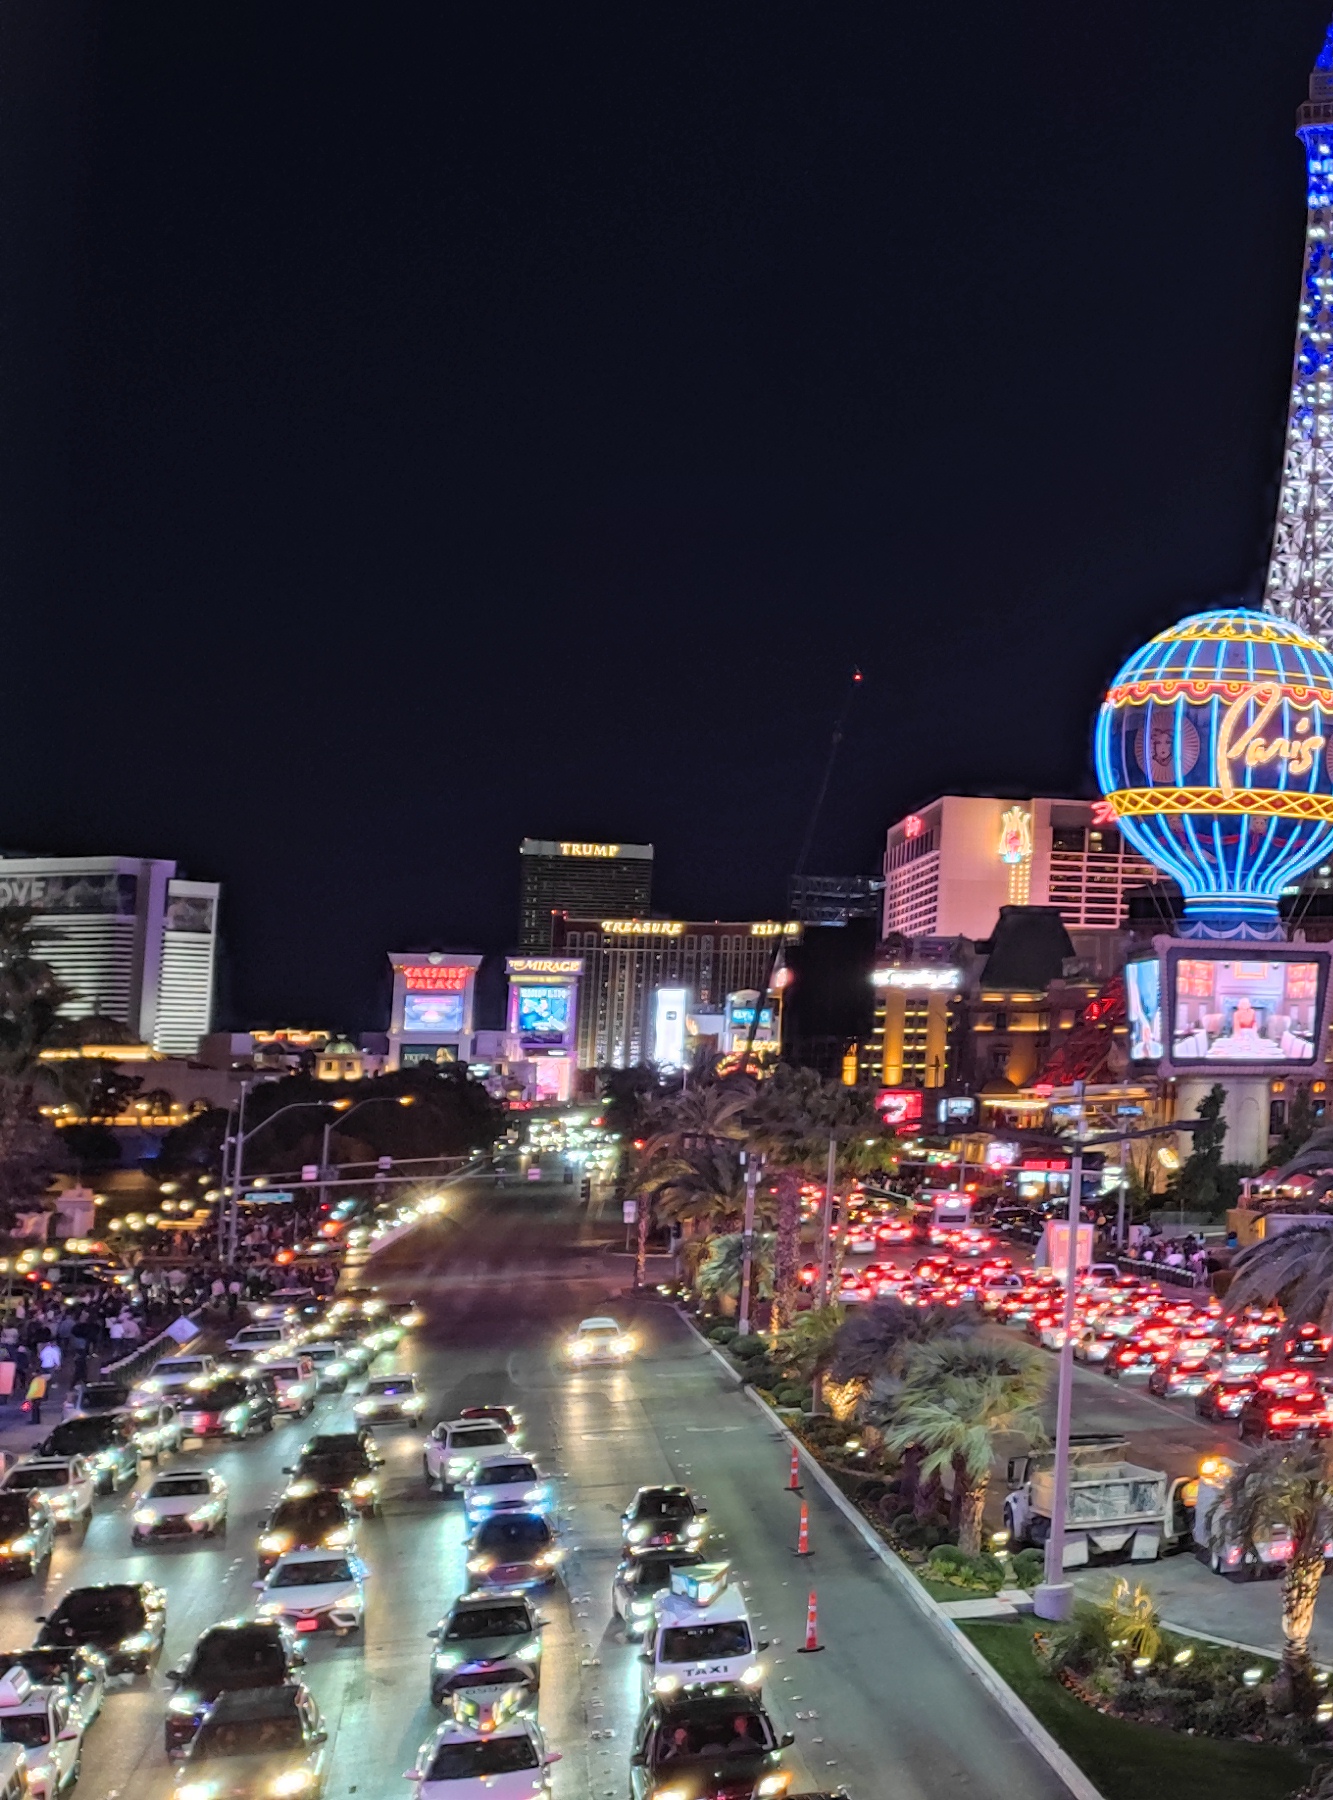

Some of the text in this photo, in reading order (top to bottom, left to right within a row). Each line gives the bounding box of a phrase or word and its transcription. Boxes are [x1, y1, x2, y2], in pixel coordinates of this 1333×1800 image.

[1217, 682, 1325, 800] Paris
[560, 843, 619, 858] TRUMP
[601, 921, 684, 934] TREASURE
[404, 966, 468, 978] CAESARS
[516, 960, 581, 974] MIRAGE
[406, 978, 464, 990] PALACE
[683, 1665, 729, 1677] TAXI
